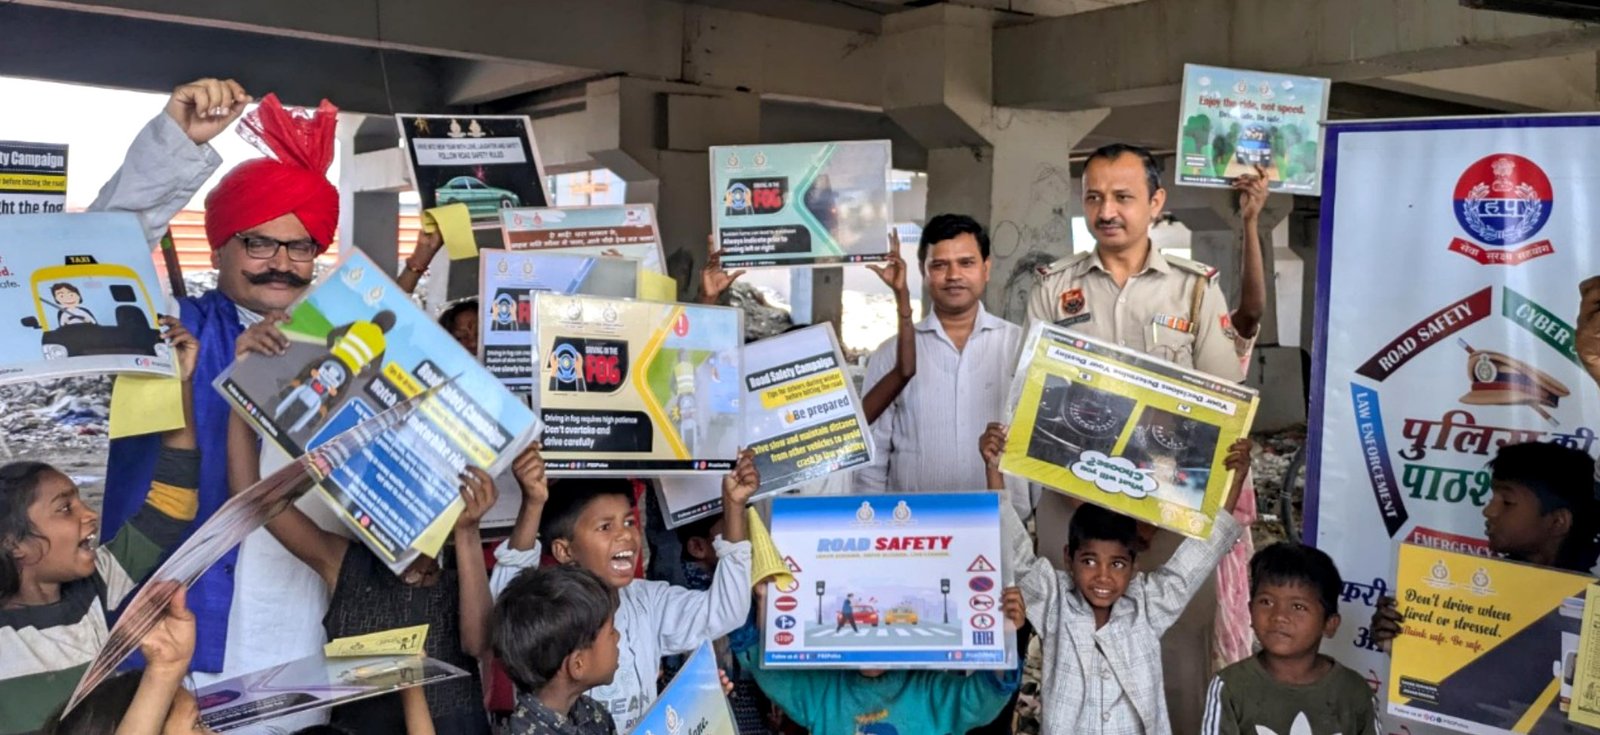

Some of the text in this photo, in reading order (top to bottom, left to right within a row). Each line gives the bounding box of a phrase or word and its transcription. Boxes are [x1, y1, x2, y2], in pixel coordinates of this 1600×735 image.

[1199, 96, 1220, 108] Enjoy
[1223, 97, 1237, 107] the
[1261, 103, 1275, 111] not
[1277, 103, 1305, 114] speed.
[0, 151, 64, 168] ty Campaign
[3, 178, 21, 186] before
[22, 178, 41, 187] hitting
[19, 200, 39, 214] the
[753, 188, 782, 209] FOG
[723, 238, 743, 246] Always
[1378, 302, 1473, 372] ROAD SAFETY
[1516, 303, 1570, 348] CYBER
[609, 347, 618, 355] THE
[585, 355, 621, 384] FOG
[749, 355, 835, 388] Road Safety Campaign
[1053, 349, 1227, 409] Your Decisions Determine Your Destiny
[766, 390, 777, 399] Tips
[787, 382, 804, 392] drivers
[806, 378, 822, 388] during
[823, 372, 840, 382] winter
[784, 379, 842, 400] before hitting the road
[367, 377, 400, 407] Watch
[402, 413, 455, 459] motorbike
[415, 361, 446, 390] Road
[458, 403, 510, 450] Campaign
[793, 394, 850, 420] Be prepared
[544, 414, 564, 424] Driving
[570, 414, 579, 424] fog
[580, 415, 601, 424] requires
[602, 416, 614, 425] high
[615, 416, 638, 425] patience
[544, 424, 611, 434] Don't overtake and
[544, 436, 595, 449] drive carefully
[768, 437, 785, 450] slow
[785, 434, 799, 444] and
[798, 425, 828, 440] maintain
[828, 417, 857, 431] distance
[770, 428, 861, 462] from other vehicles to avoid
[823, 449, 835, 459] low
[1357, 392, 1398, 519] LAW ENFORCEMENT
[1079, 464, 1144, 491] What will you
[1085, 456, 1144, 481] Choose?
[817, 536, 953, 552] ROAD SAFETY
[1405, 588, 1511, 621] Don't drive when
[1404, 606, 1502, 637] tired or stressed.
[775, 634, 793, 643] STOP
[1430, 632, 1448, 646] safe.
[1451, 635, 1463, 646] Be
[1466, 641, 1485, 653] safe.
